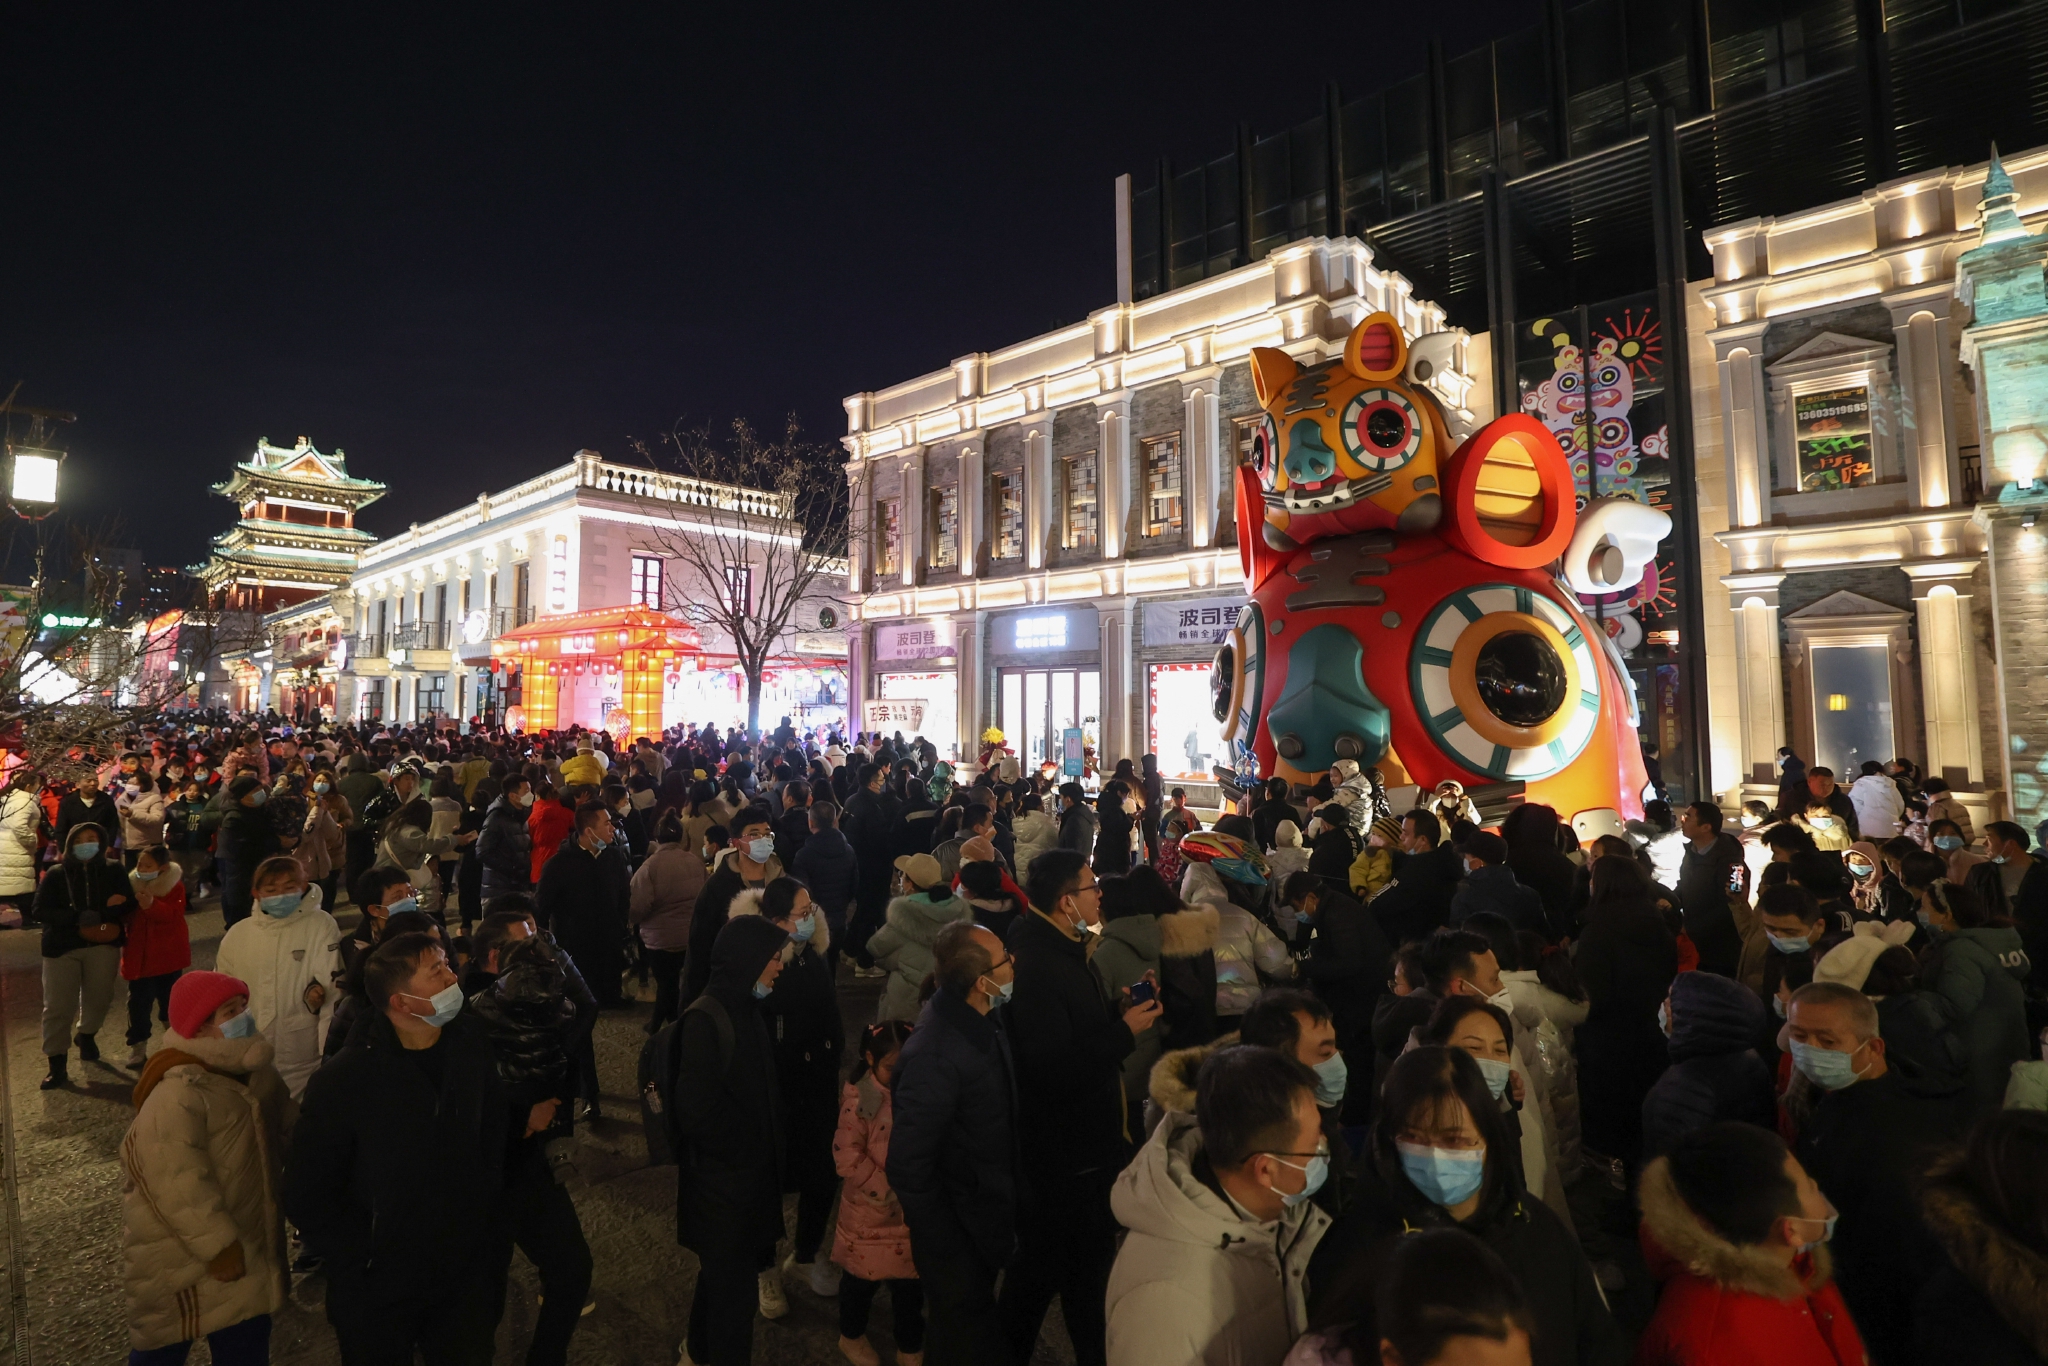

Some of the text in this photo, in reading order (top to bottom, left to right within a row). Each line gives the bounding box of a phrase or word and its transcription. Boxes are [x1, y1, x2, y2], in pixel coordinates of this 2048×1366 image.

[1179, 606, 1243, 627] 波司登
[897, 630, 935, 646] 波司登
